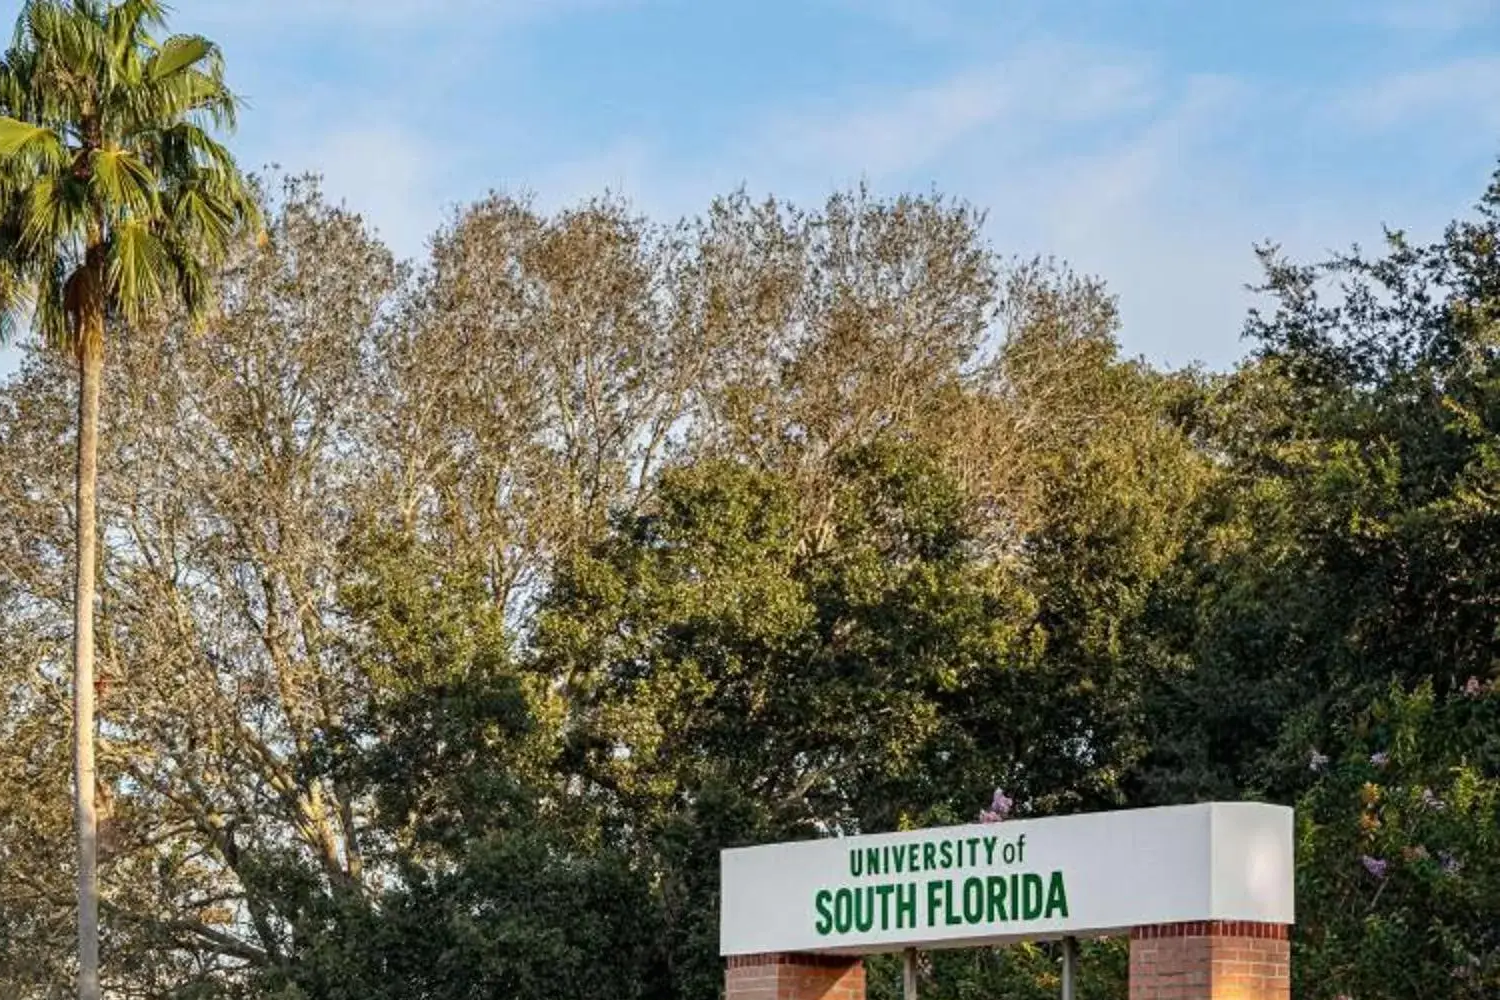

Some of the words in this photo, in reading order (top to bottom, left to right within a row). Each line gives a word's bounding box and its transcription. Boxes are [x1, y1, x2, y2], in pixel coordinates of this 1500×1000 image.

[850, 836, 997, 877] UNIVERSITY
[1003, 834, 1026, 864] of
[815, 882, 917, 935] SOUTH
[927, 870, 1069, 928] FLORIDA
